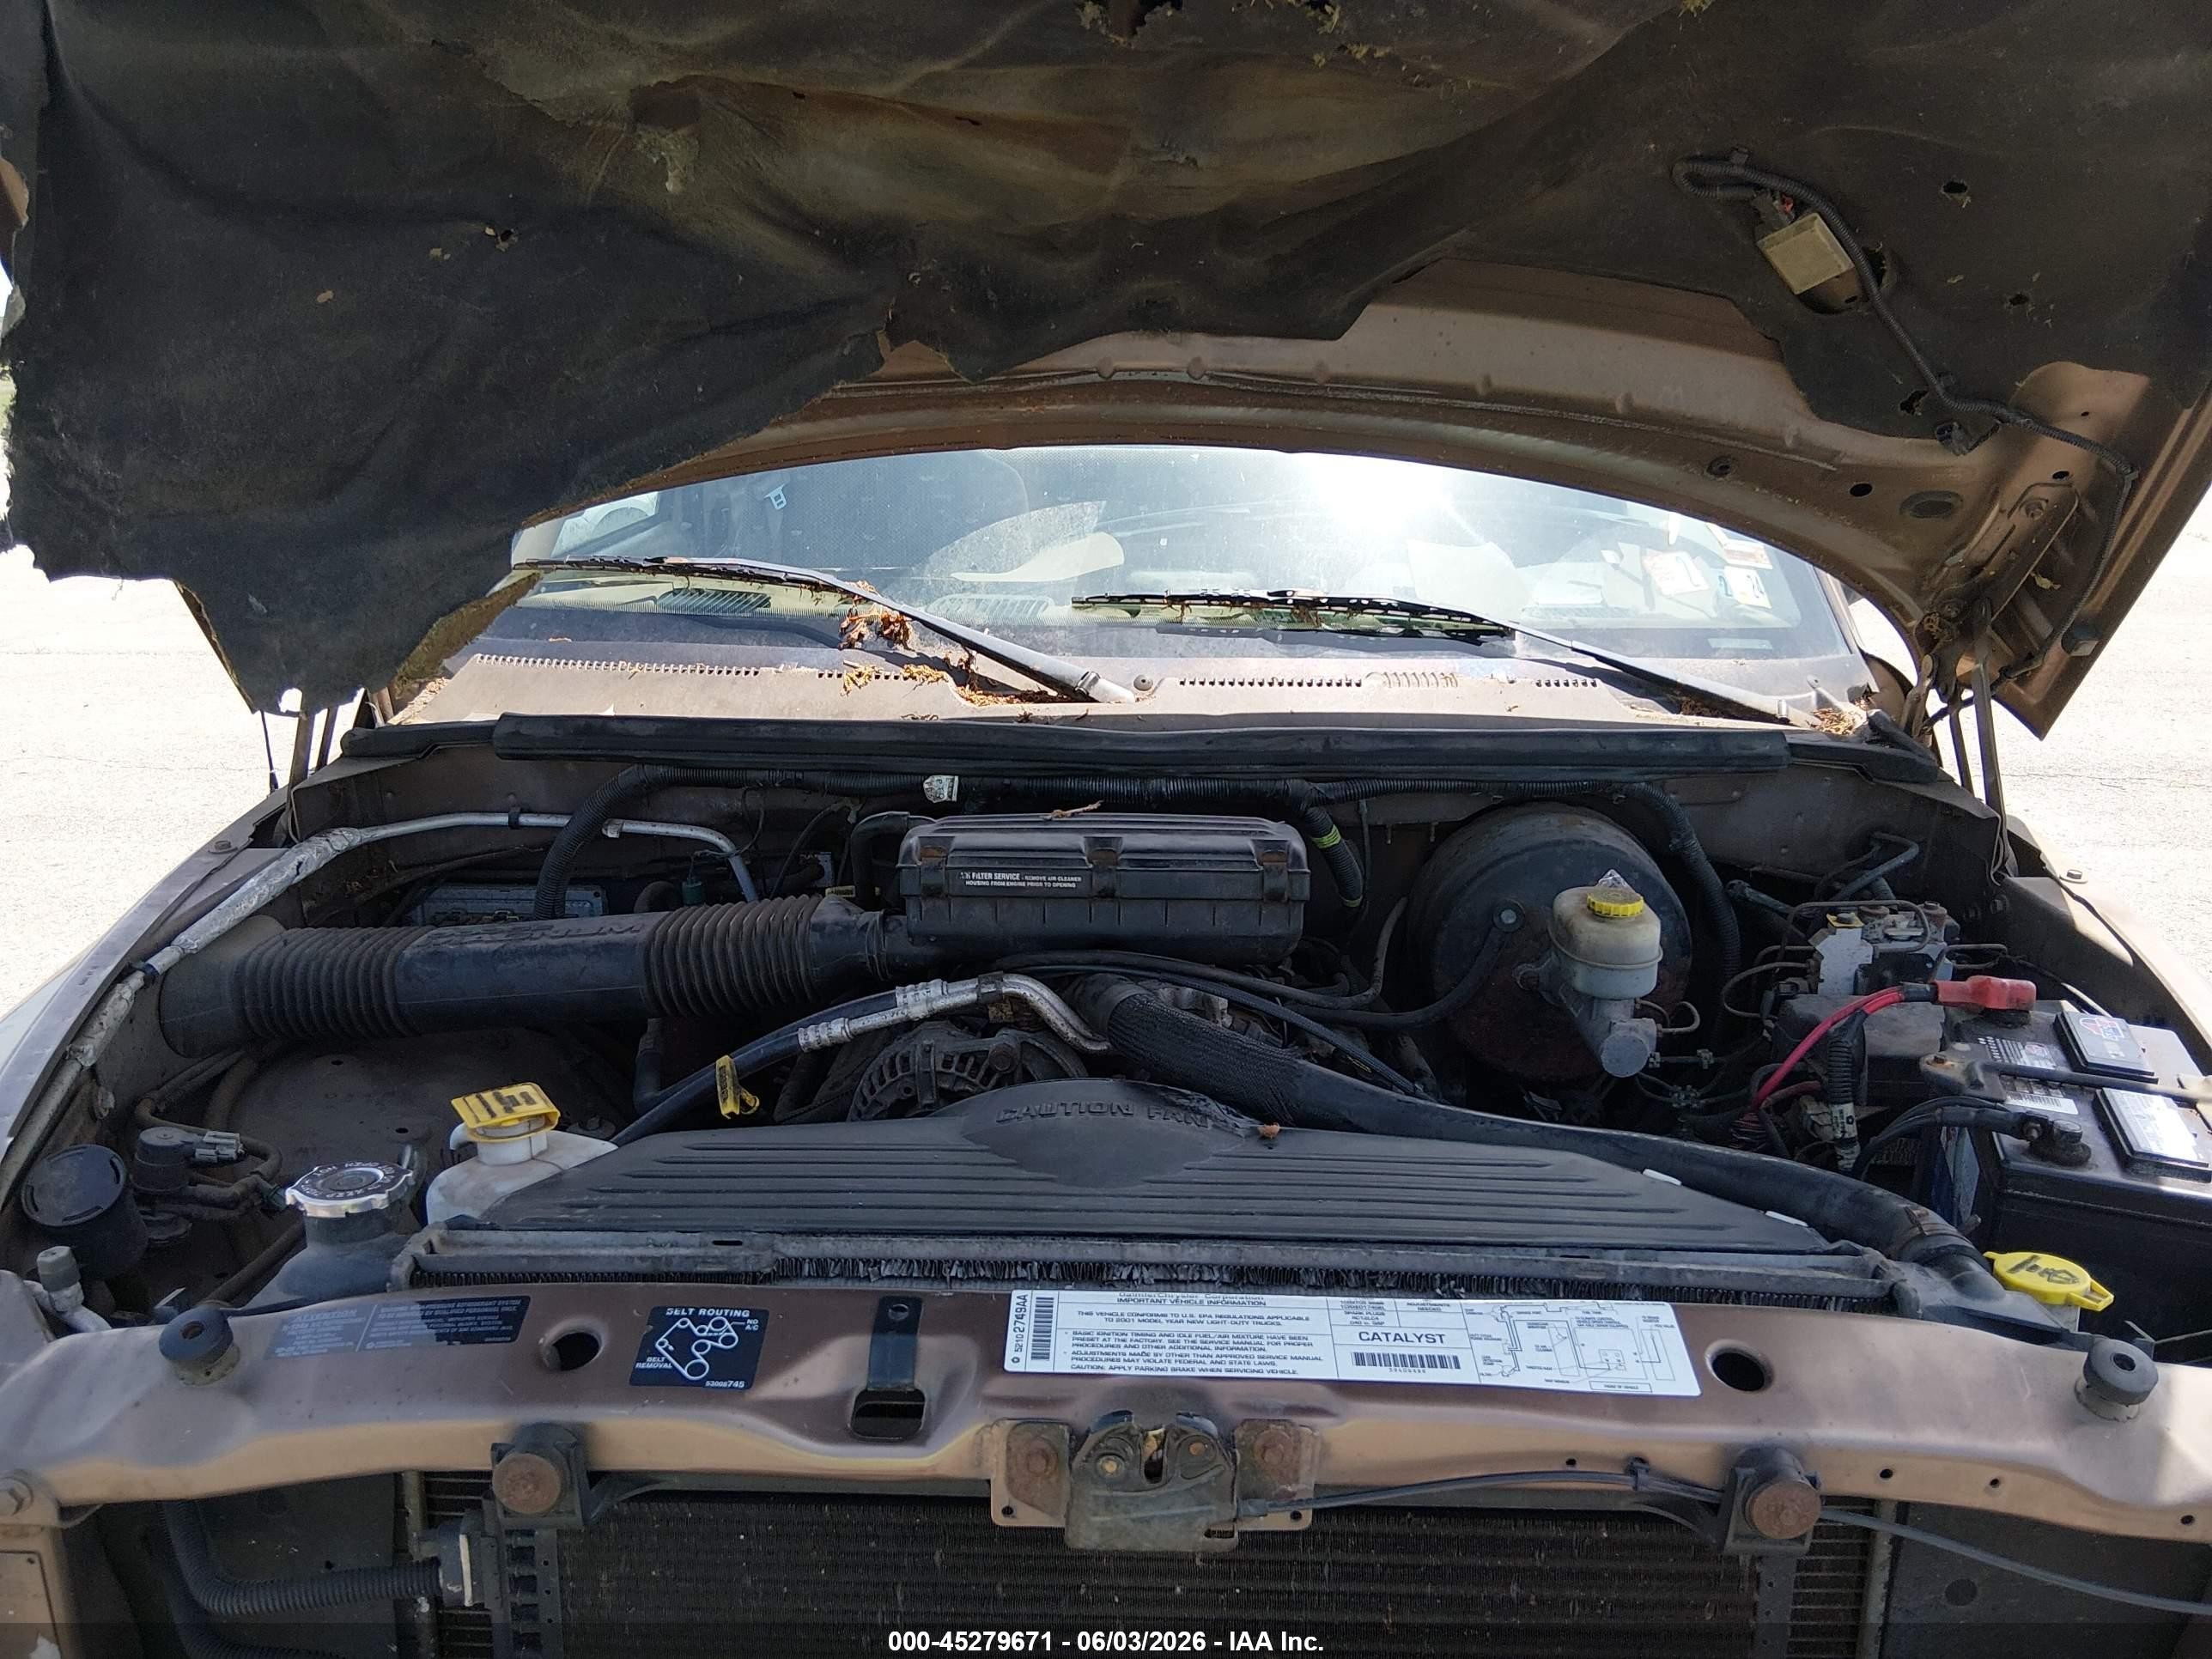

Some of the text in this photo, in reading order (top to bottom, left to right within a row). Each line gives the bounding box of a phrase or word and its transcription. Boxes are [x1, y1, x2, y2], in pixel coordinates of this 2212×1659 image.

[971, 872, 993, 880] FILTER
[994, 872, 1021, 881] SERVICE
[995, 1101, 1212, 1128] CAUTION FAN
[665, 1307, 750, 1318] BELT ROUTING
[1358, 1331, 1446, 1345] CATALYST
